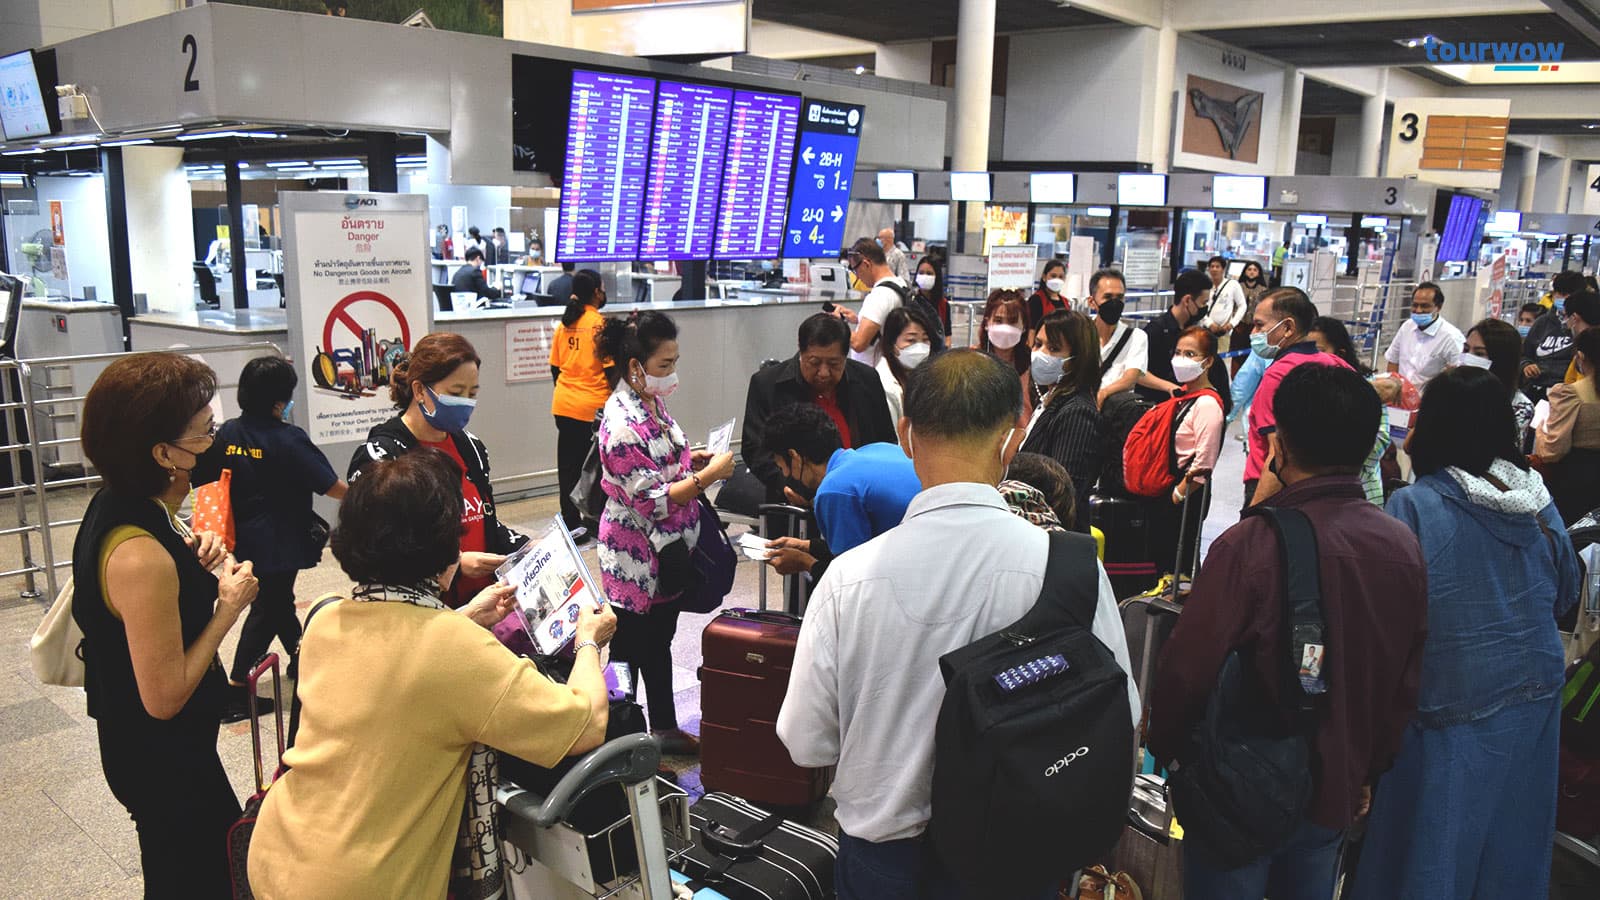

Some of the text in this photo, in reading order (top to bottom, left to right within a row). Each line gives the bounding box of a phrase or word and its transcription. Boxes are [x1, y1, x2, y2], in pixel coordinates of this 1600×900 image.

[181, 34, 200, 93] 2
[1398, 113, 1419, 142] 3
[819, 151, 843, 168] 2B-H
[833, 170, 841, 190] 1
[1384, 187, 1398, 205] 3
[801, 207, 825, 223] 2J-Q
[347, 232, 379, 242] Danger
[808, 224, 819, 244] 4
[324, 270, 358, 278] Dangerous
[568, 336, 580, 351] 91
[1541, 335, 1571, 349] NIKE
[463, 496, 483, 516] AY
[1044, 746, 1089, 777] oppo
